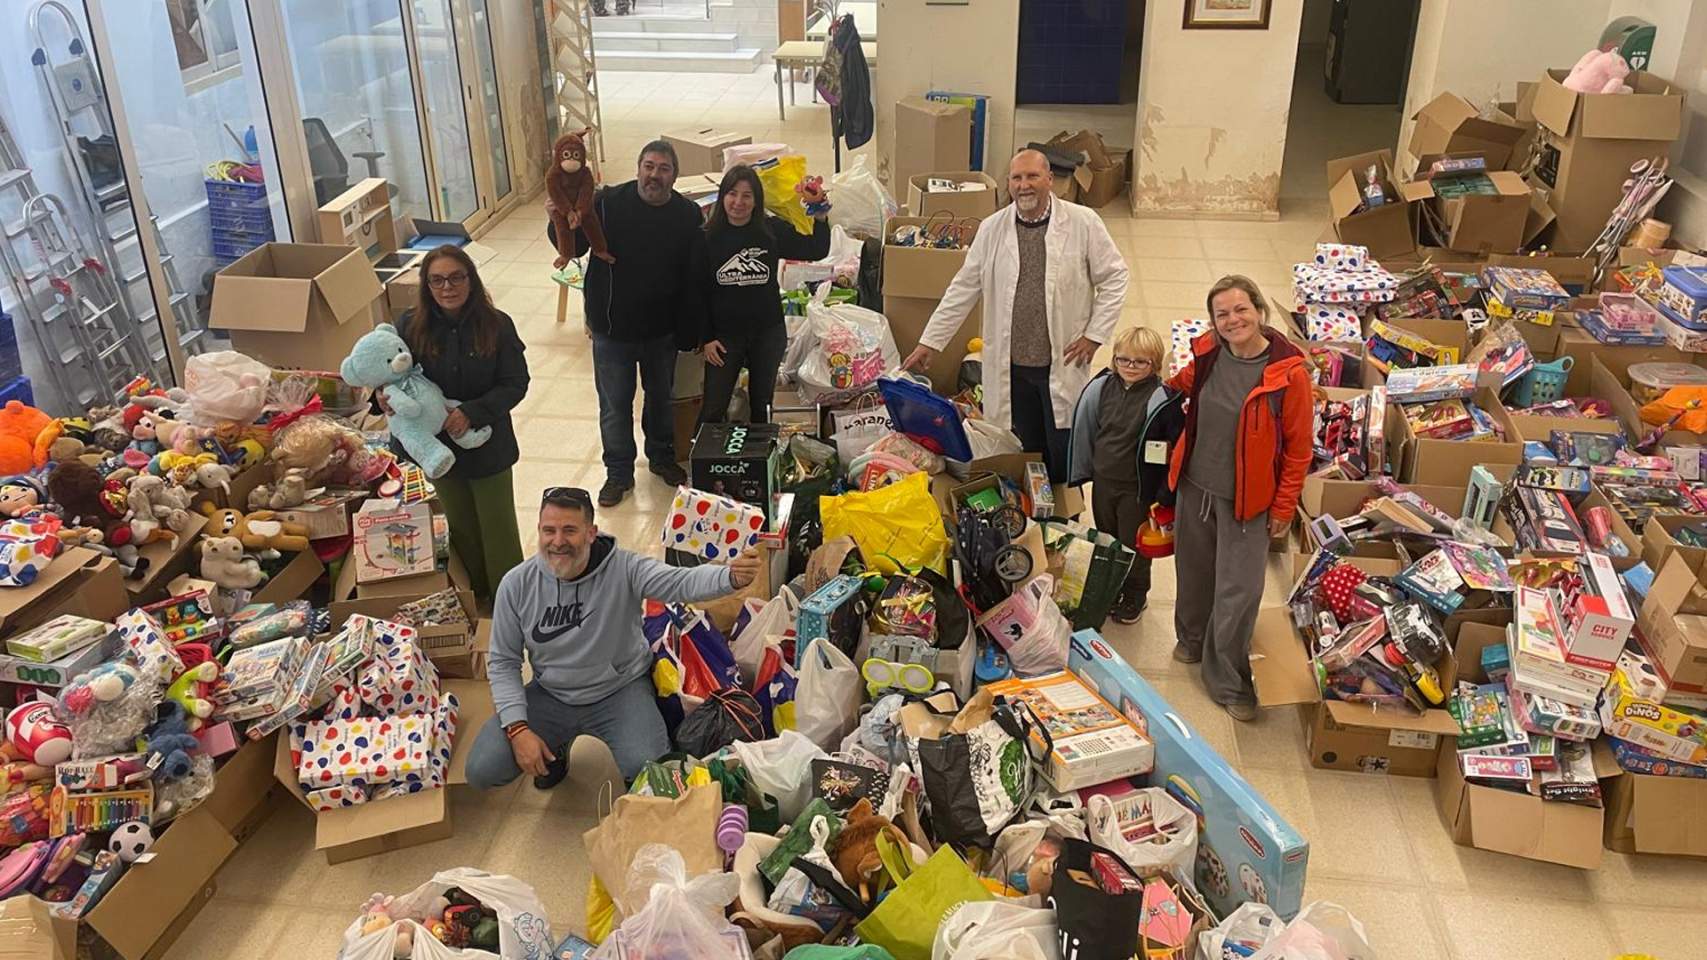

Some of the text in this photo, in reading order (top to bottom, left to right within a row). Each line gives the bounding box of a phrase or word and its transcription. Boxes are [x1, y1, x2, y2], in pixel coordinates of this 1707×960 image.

[725, 426, 748, 455] JOCCA
[709, 464, 746, 474] JOCCA
[541, 602, 584, 627] NIKE
[1593, 624, 1618, 636] CITY
